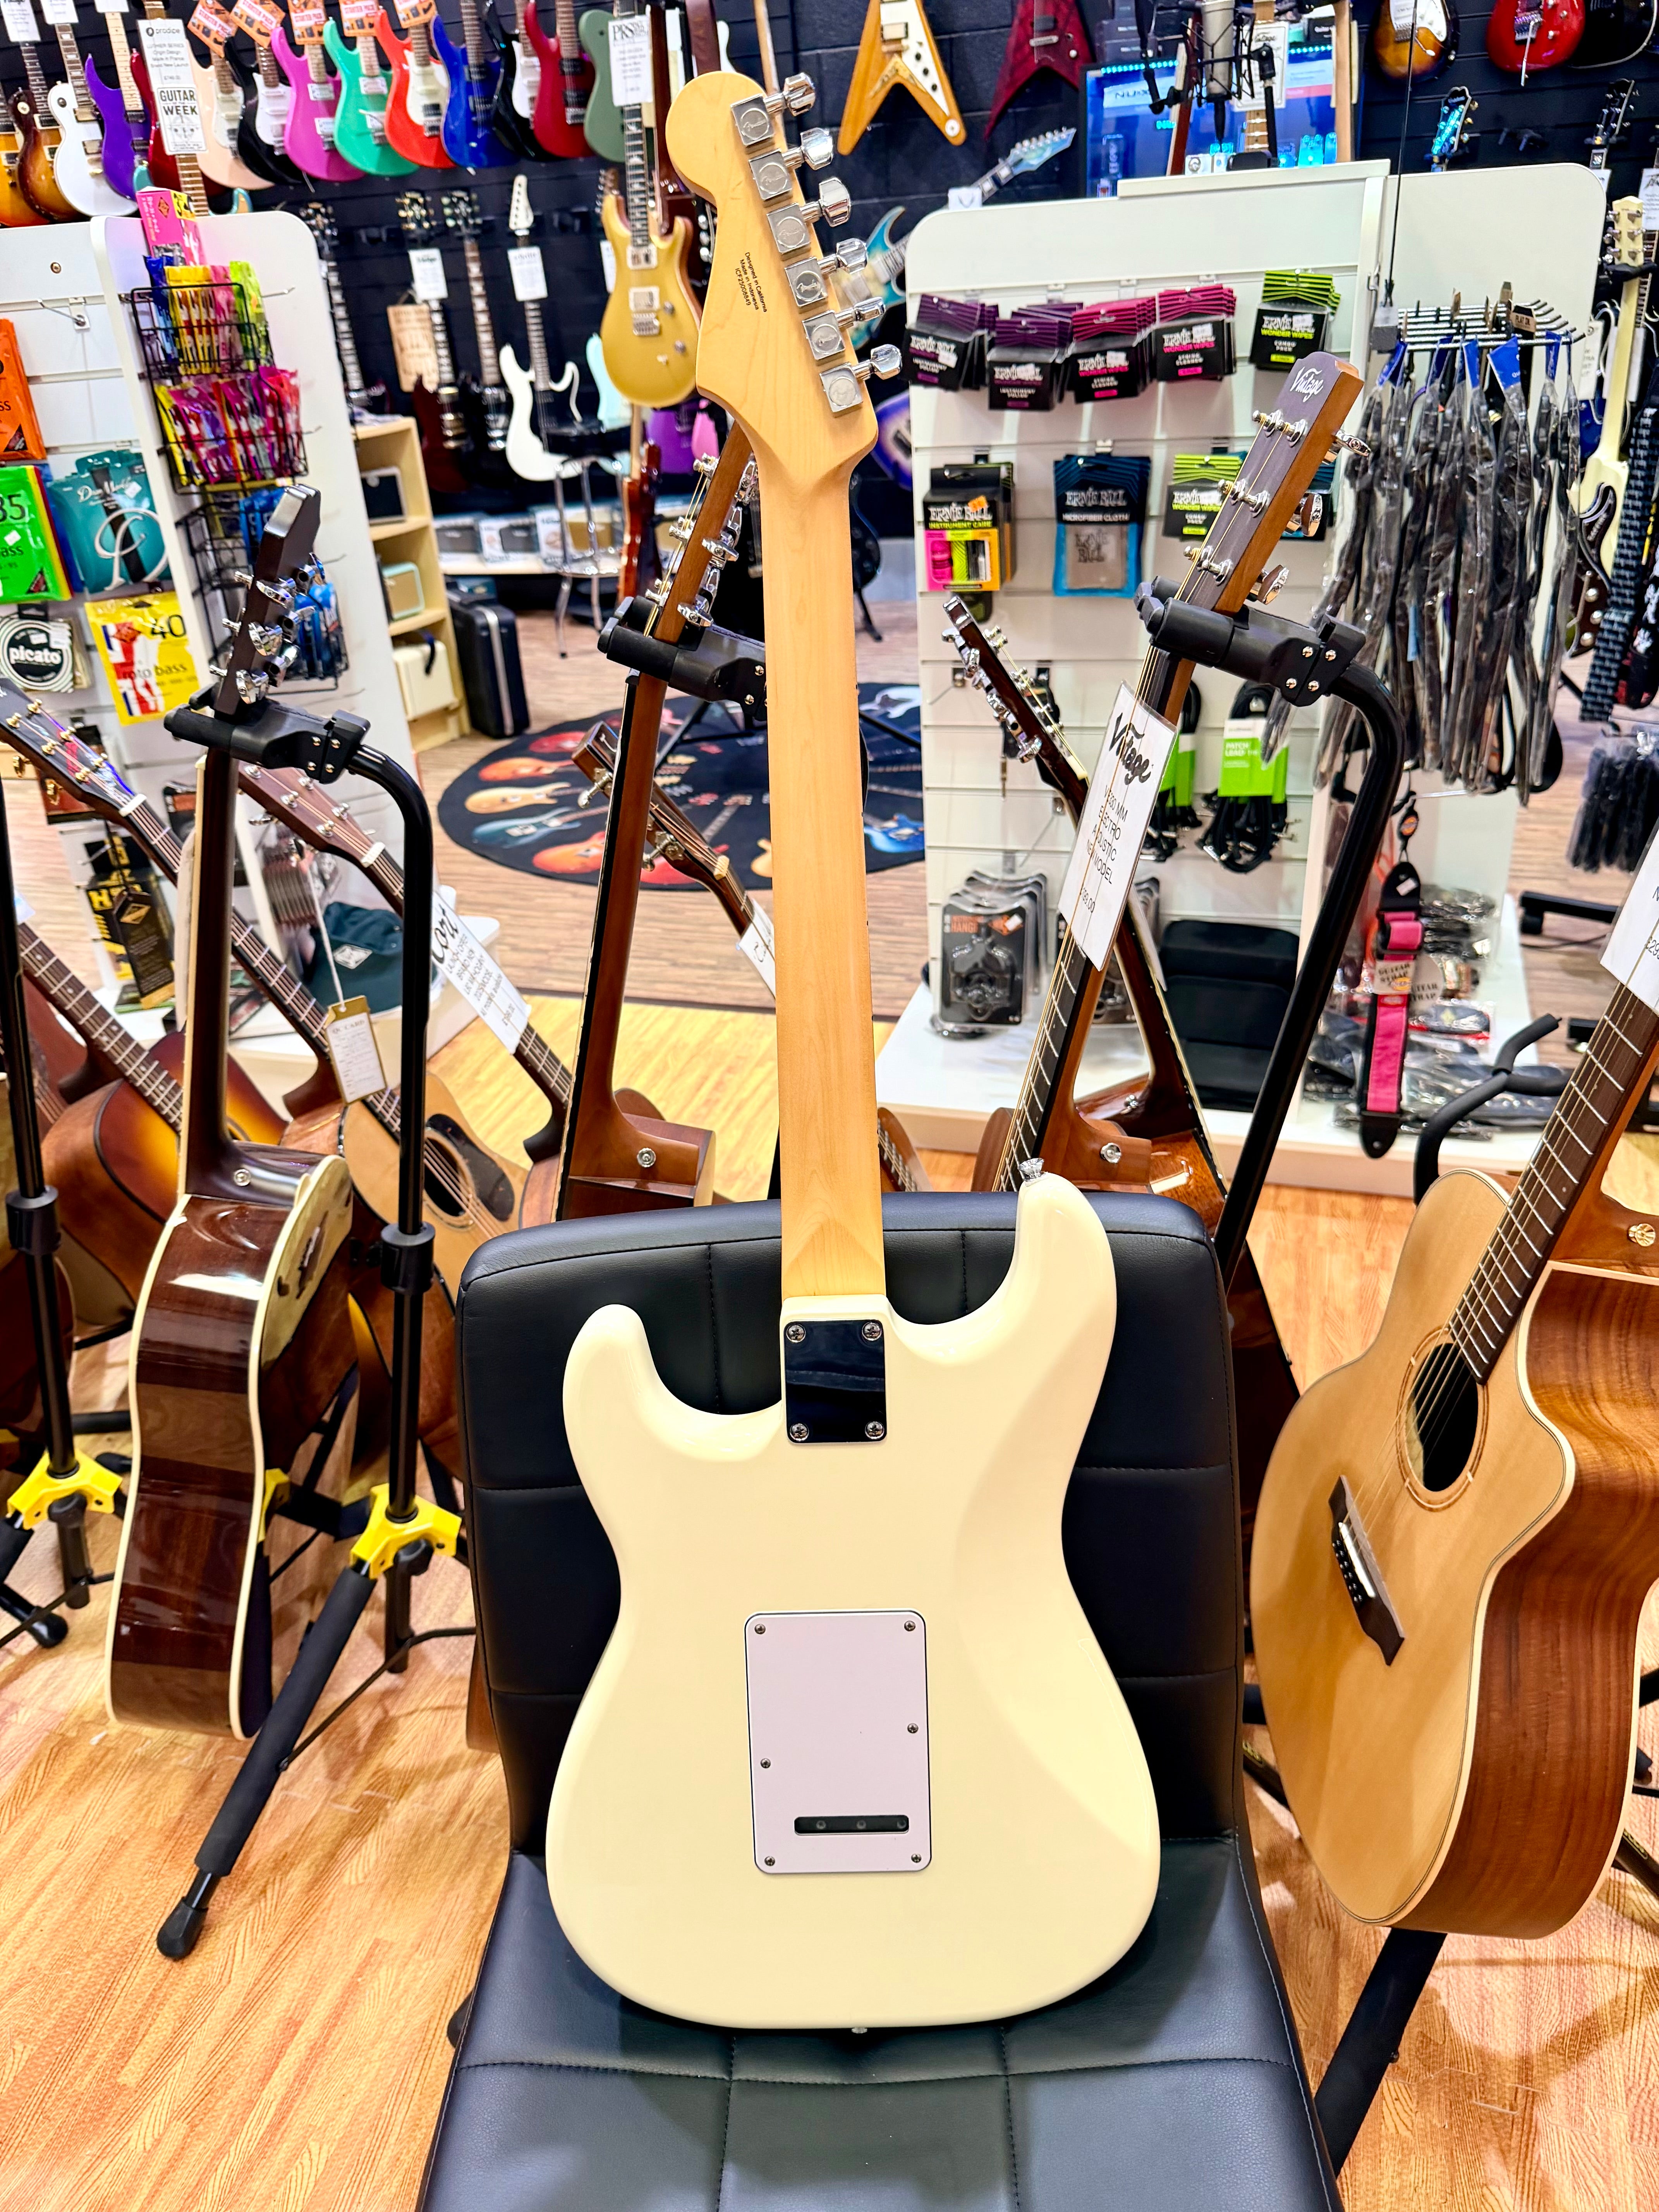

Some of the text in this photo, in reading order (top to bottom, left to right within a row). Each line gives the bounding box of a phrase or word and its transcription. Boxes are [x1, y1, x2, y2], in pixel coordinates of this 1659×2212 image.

[160, 90, 196, 102] GUITAR
[163, 105, 198, 115] WEEK
[735, 268, 751, 306] ICF25008849
[745, 252, 757, 279] Designed
[756, 286, 767, 313] California
[747, 283, 759, 310] Indonesia
[1262, 314, 1292, 331] ERNIE
[1162, 328, 1192, 347] ERNIE
[1261, 328, 1314, 339] WONDER WIPES
[910, 335, 936, 353] ERNIE
[1163, 341, 1215, 354] WONDER WIPES
[1077, 352, 1106, 372] ERNIE
[1290, 366, 1324, 403] Vintage
[1065, 485, 1128, 507] ERNIE BALL
[927, 502, 963, 522] ERNIE
[1172, 502, 1200, 511] WONDER
[929, 520, 972, 529] INSTRUMENT
[1104, 513, 1130, 522] CLOTH
[1, 545, 24, 557] ass
[151, 614, 186, 639] 40
[9, 645, 62, 665] picato
[122, 664, 187, 679] roto bass
[1099, 805, 1121, 840] EECTRO
[1116, 802, 1128, 823] MM
[1092, 824, 1117, 861] AOUSTIC
[1094, 857, 1112, 884] MODEL
[431, 903, 459, 965] Cort
